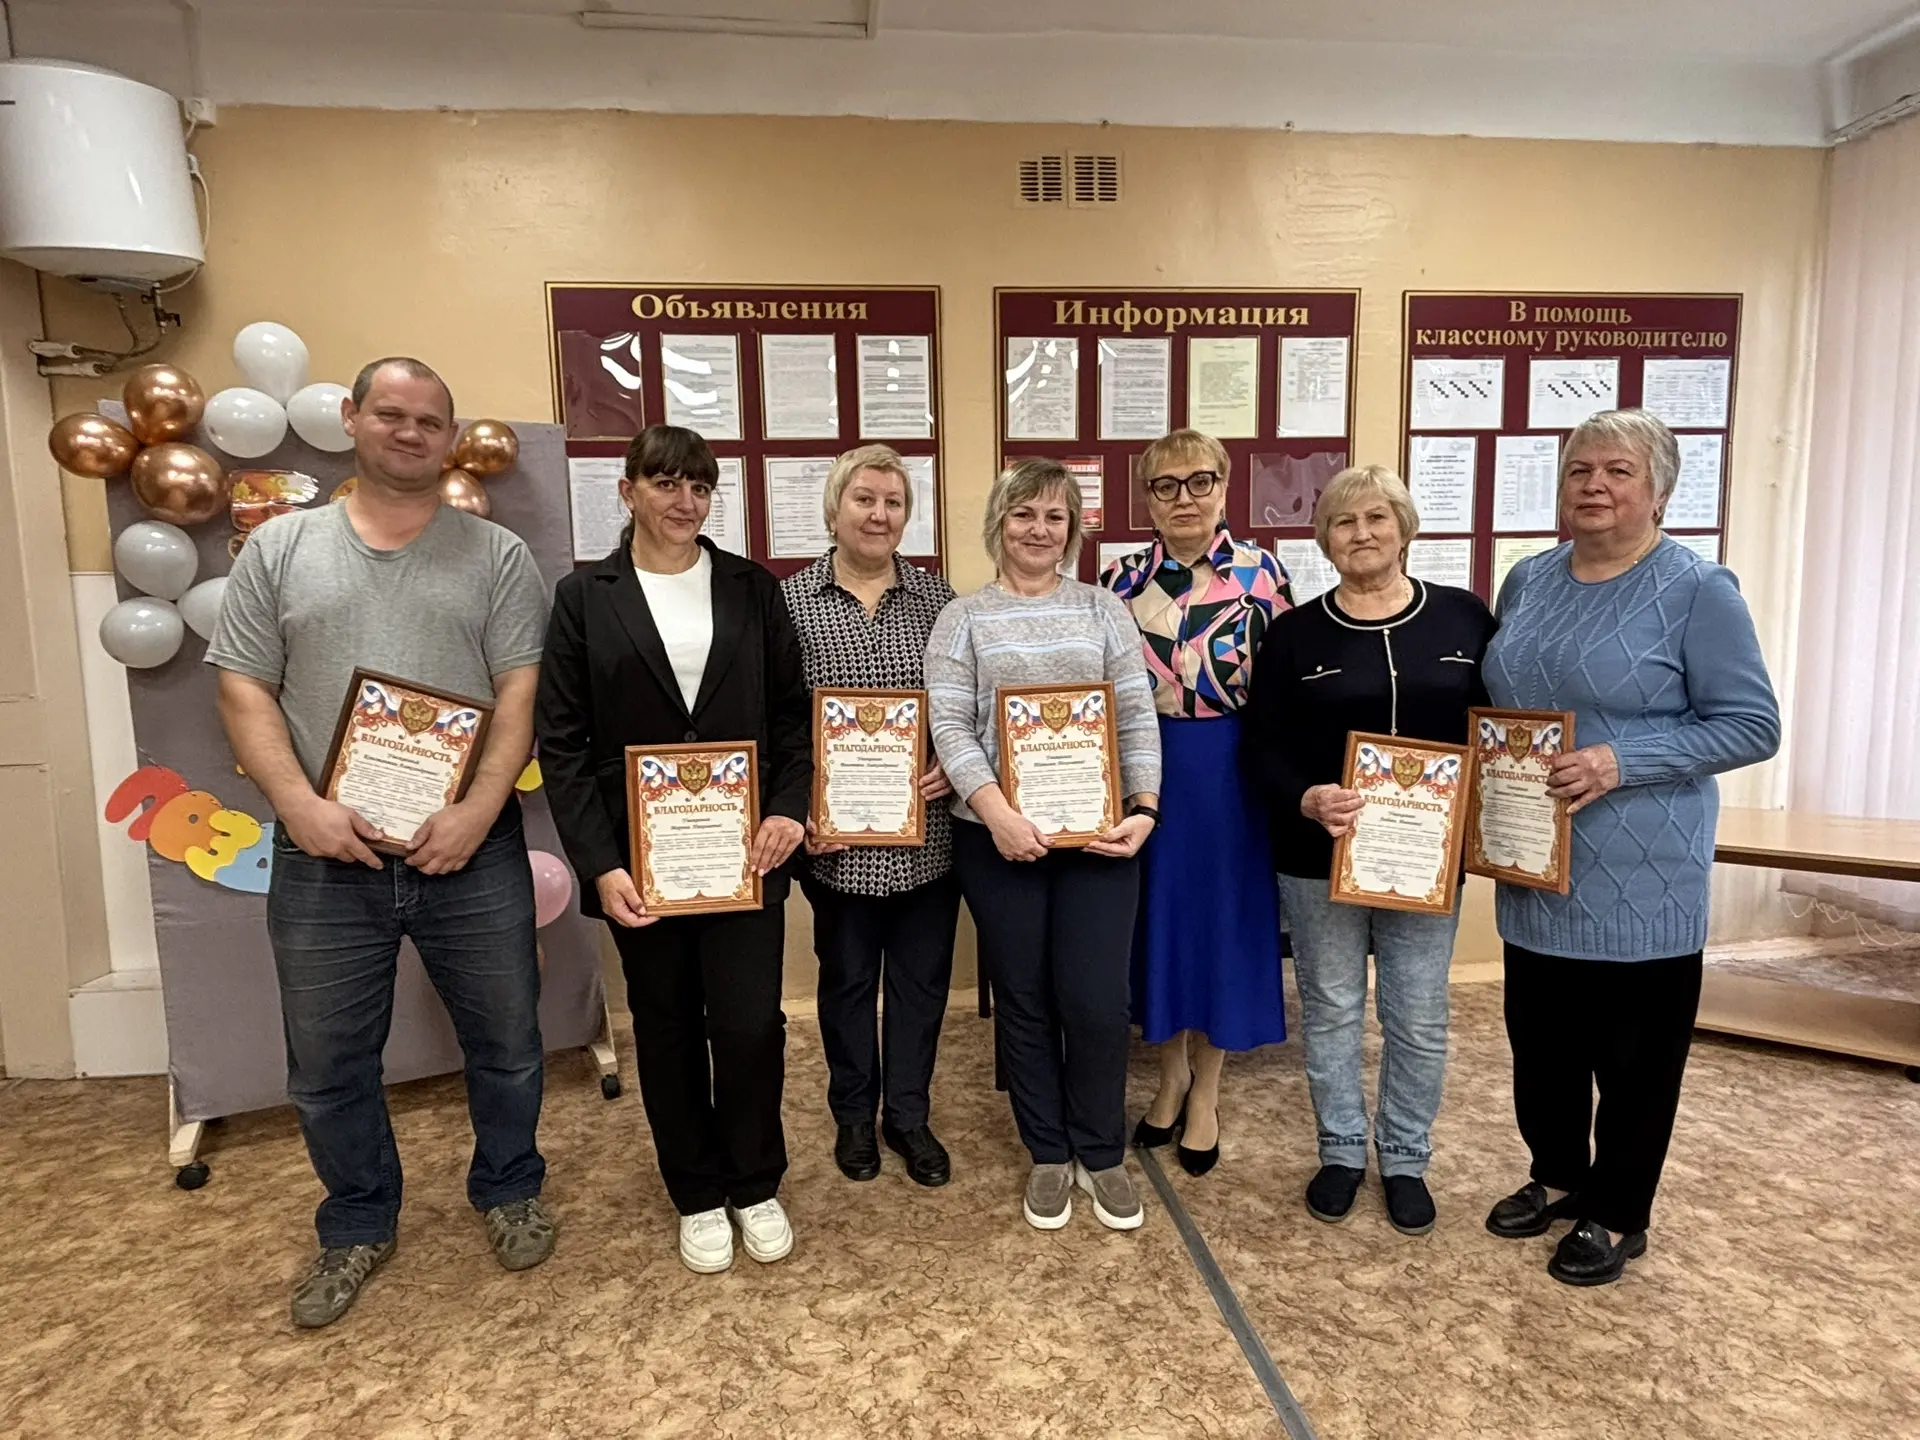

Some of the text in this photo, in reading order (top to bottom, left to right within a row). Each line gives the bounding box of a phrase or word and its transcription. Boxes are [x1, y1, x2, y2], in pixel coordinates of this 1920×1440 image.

[631, 293, 868, 320] Объявления
[1052, 299, 1310, 333] Информация
[1509, 300, 1632, 325] В помощь
[1415, 326, 1728, 352] классному руководителю
[361, 733, 452, 763] БЛАГОДАРНОСТЬ
[833, 744, 907, 753] БЛАГОДАРНОСТЬ
[1020, 740, 1097, 753] БЛАГОДАРНОСТЬ
[1486, 769, 1548, 784] БЛАГОДАРНОСТ
[654, 803, 738, 816] БЛАГОДАРНОСТЬ
[1364, 794, 1443, 813] БЛАГОДАРНОСТЬ
